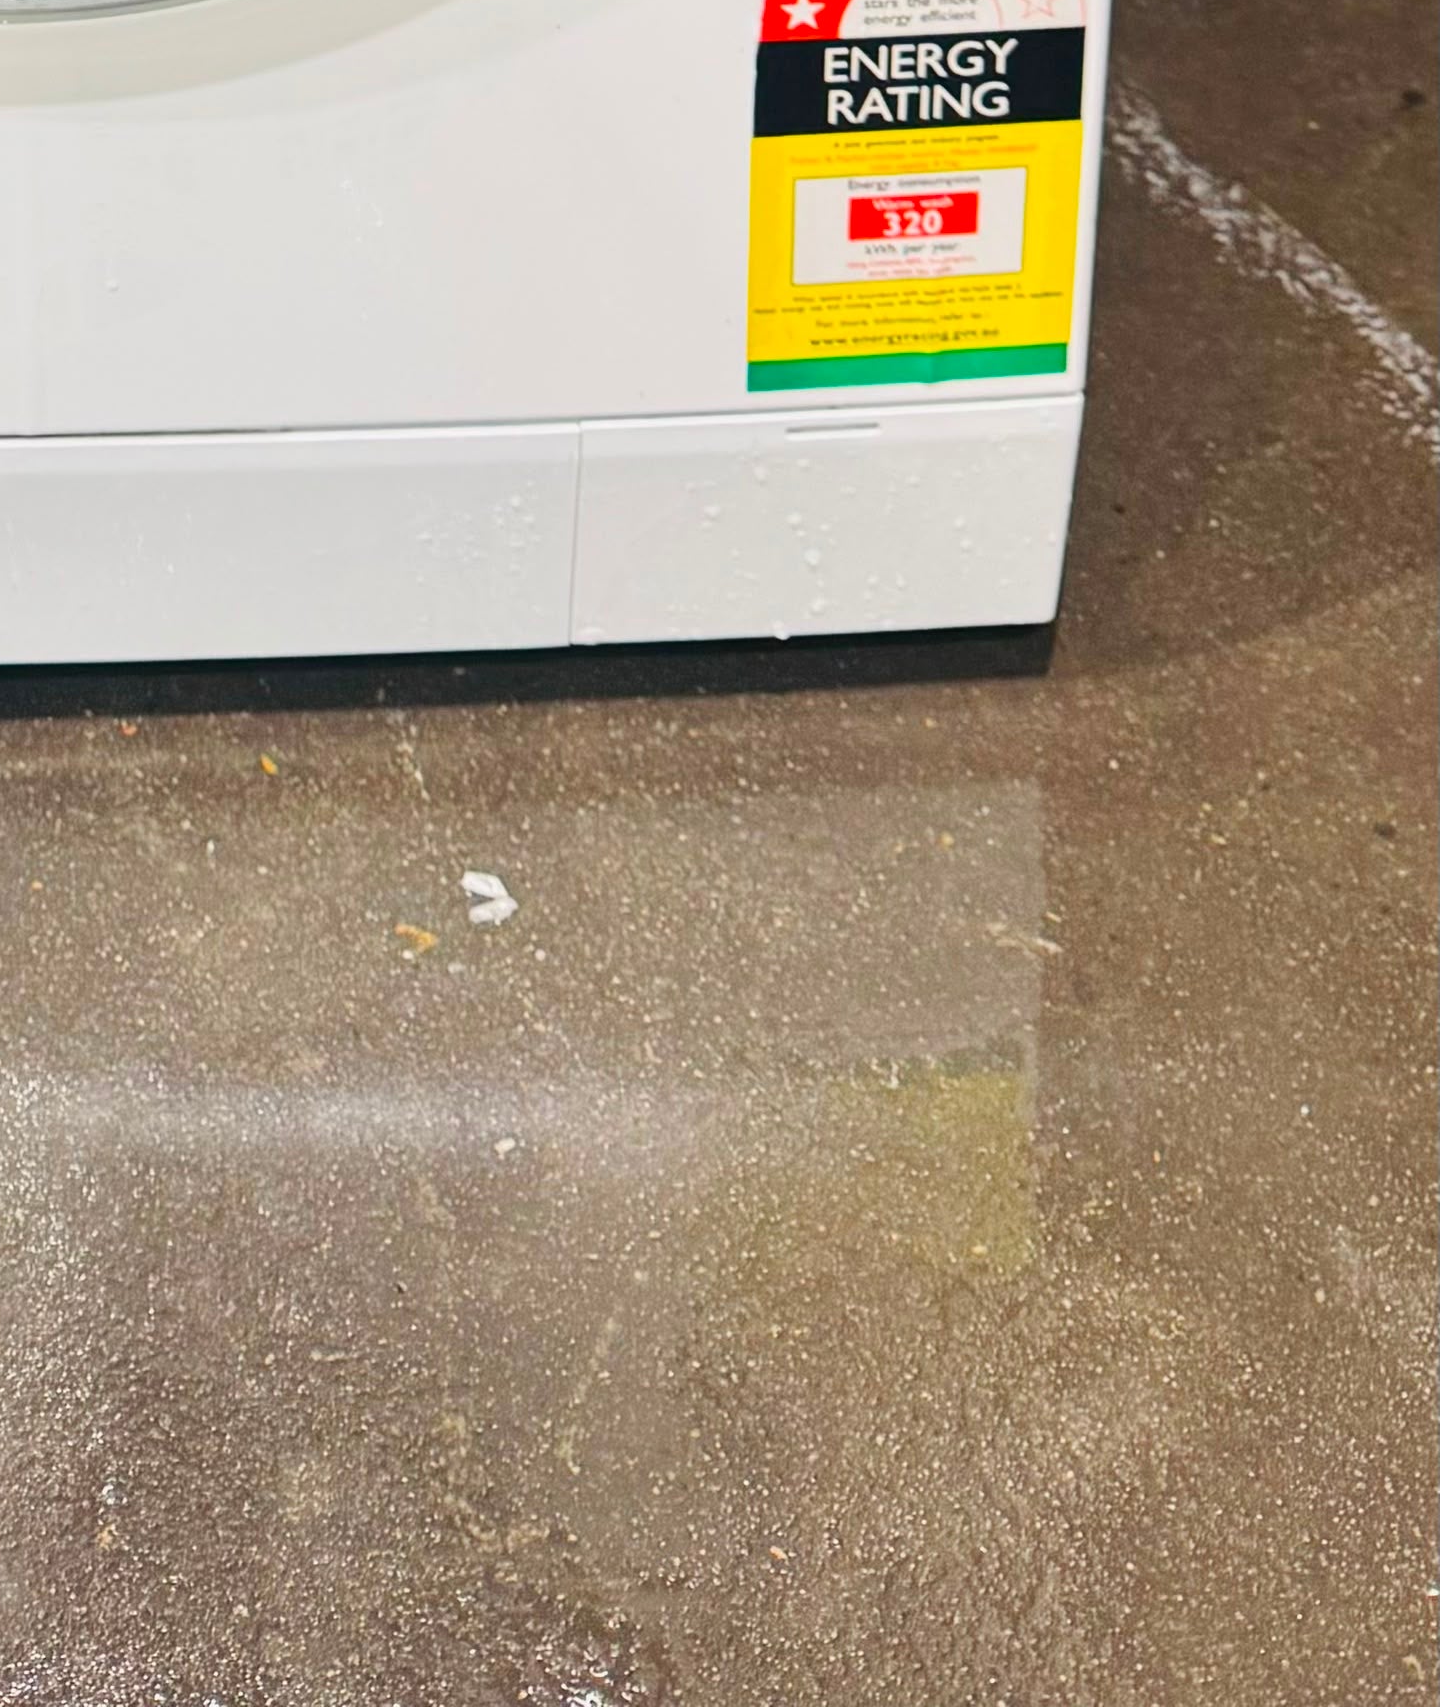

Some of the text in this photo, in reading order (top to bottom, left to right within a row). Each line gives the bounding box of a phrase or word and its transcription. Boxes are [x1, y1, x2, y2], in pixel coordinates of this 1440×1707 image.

[865, 0, 898, 9] stars
[864, 11, 976, 26] energy efficient
[824, 39, 1019, 84] ENERGY
[827, 83, 1010, 126] RATING
[883, 210, 943, 237] 320
